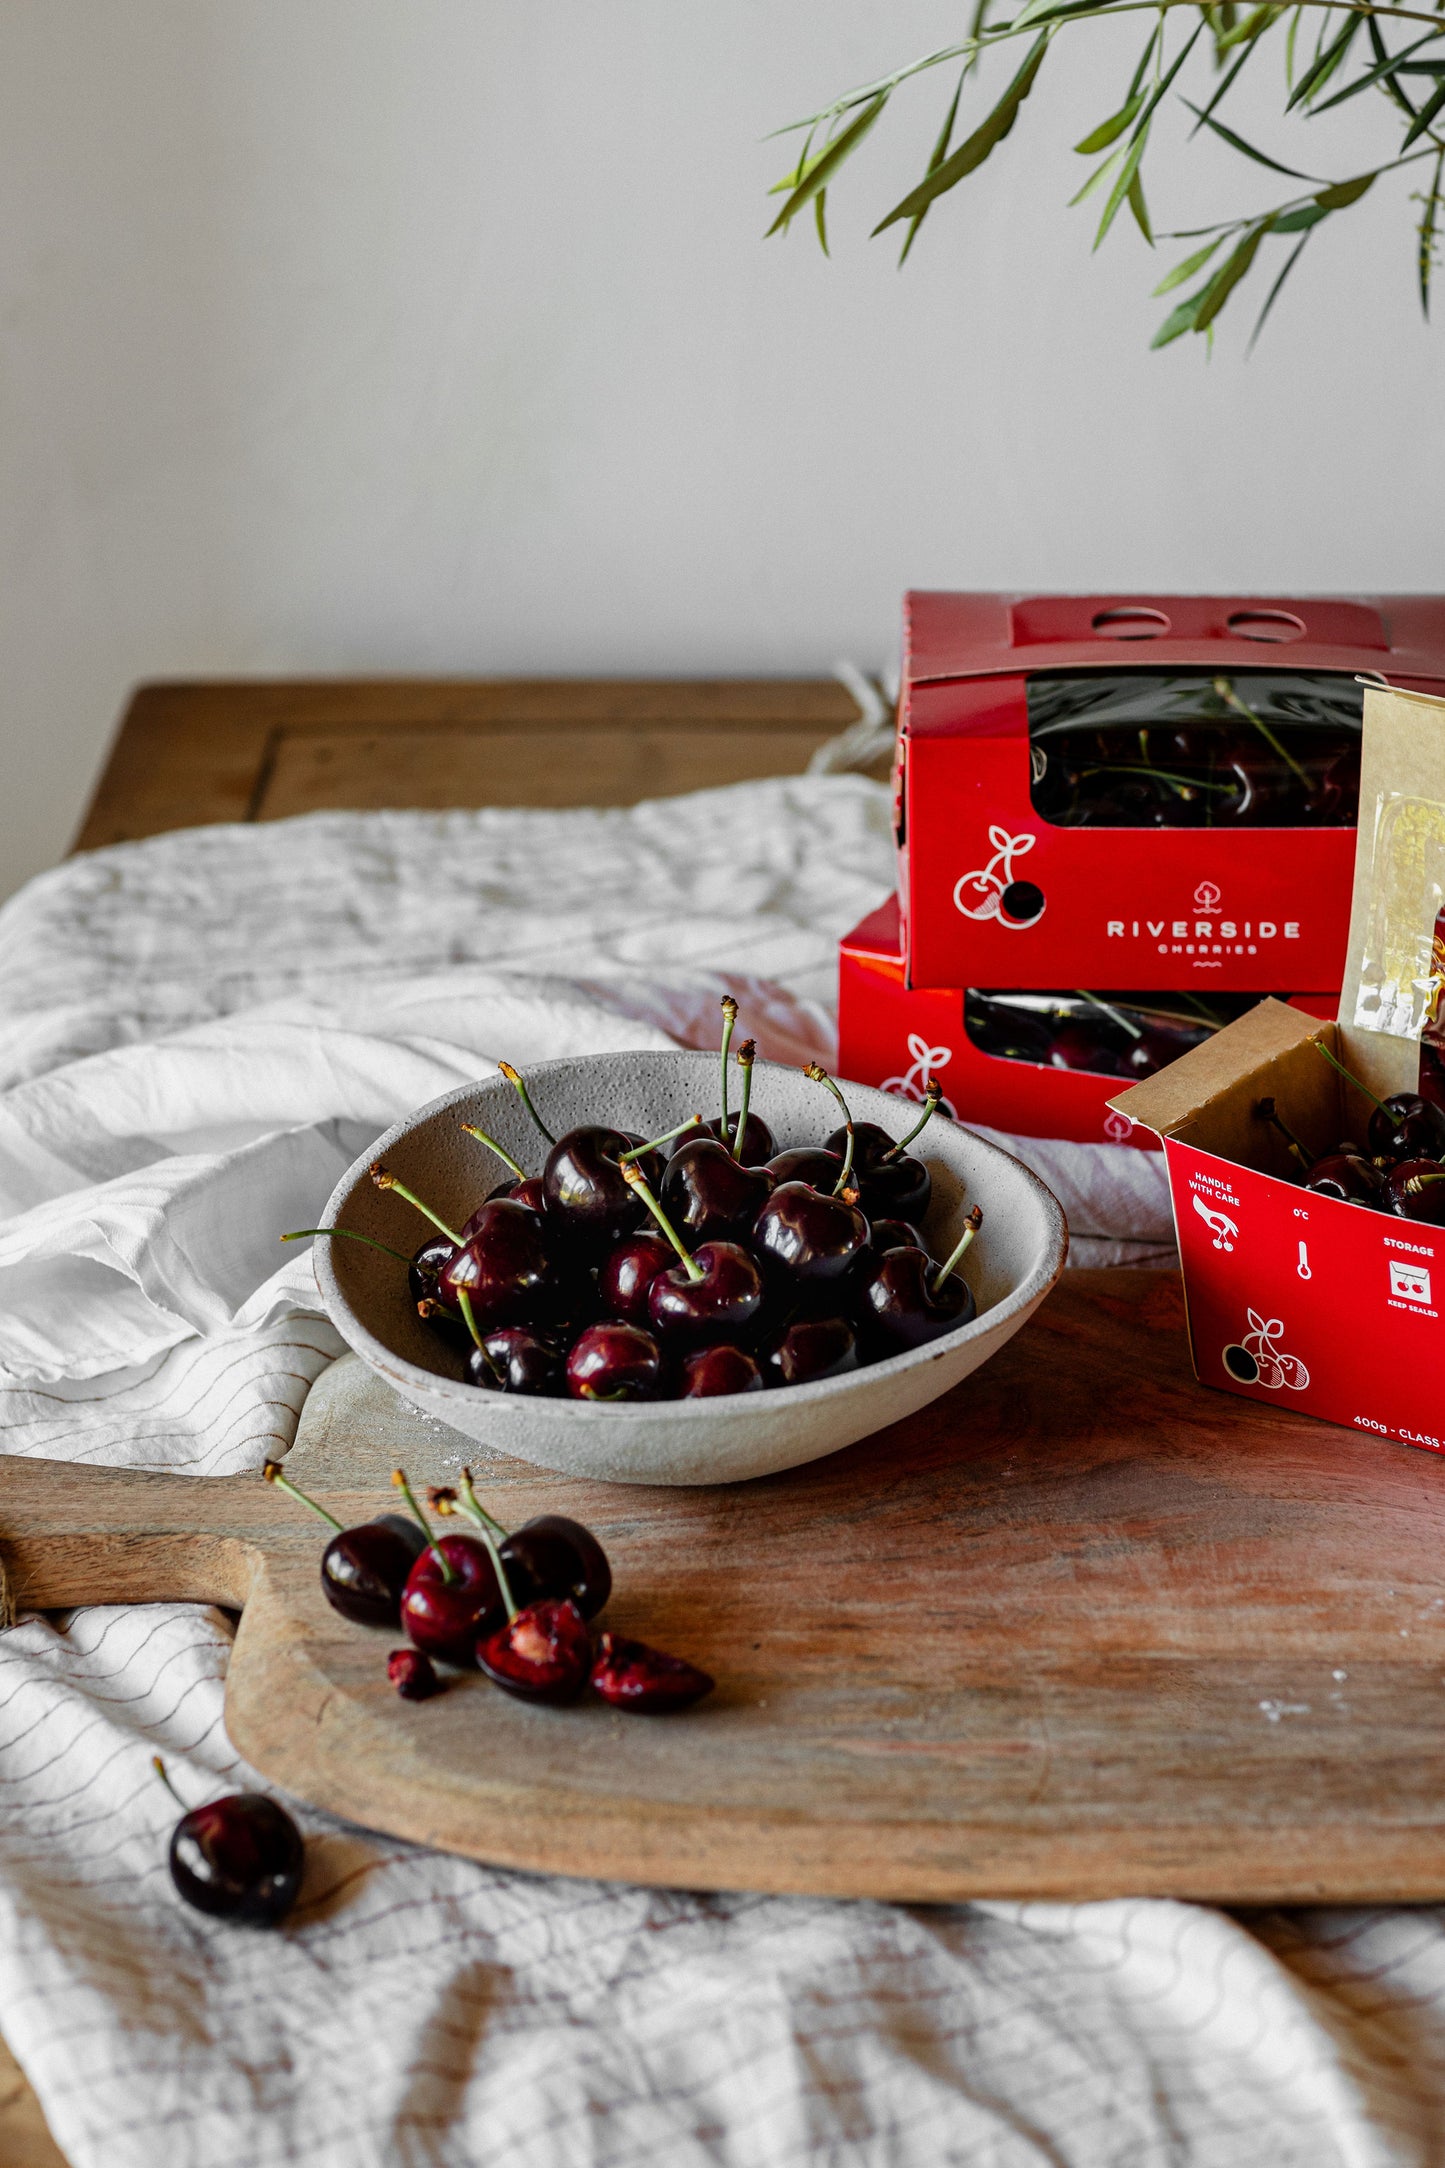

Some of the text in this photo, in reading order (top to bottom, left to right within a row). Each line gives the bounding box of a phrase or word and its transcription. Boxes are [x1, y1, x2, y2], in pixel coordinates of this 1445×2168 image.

[1107, 921, 1300, 938] RIVERSIDE
[1158, 944, 1257, 955] CHERRIES
[1195, 1171, 1232, 1193] HANDLE
[1188, 1180, 1240, 1207] WITH CARE
[1383, 1237, 1435, 1257] STORAGE
[1387, 1299, 1439, 1318] KEEP SEALED
[1353, 1415, 1388, 1434] 400g
[1398, 1428, 1440, 1448] CLASS
